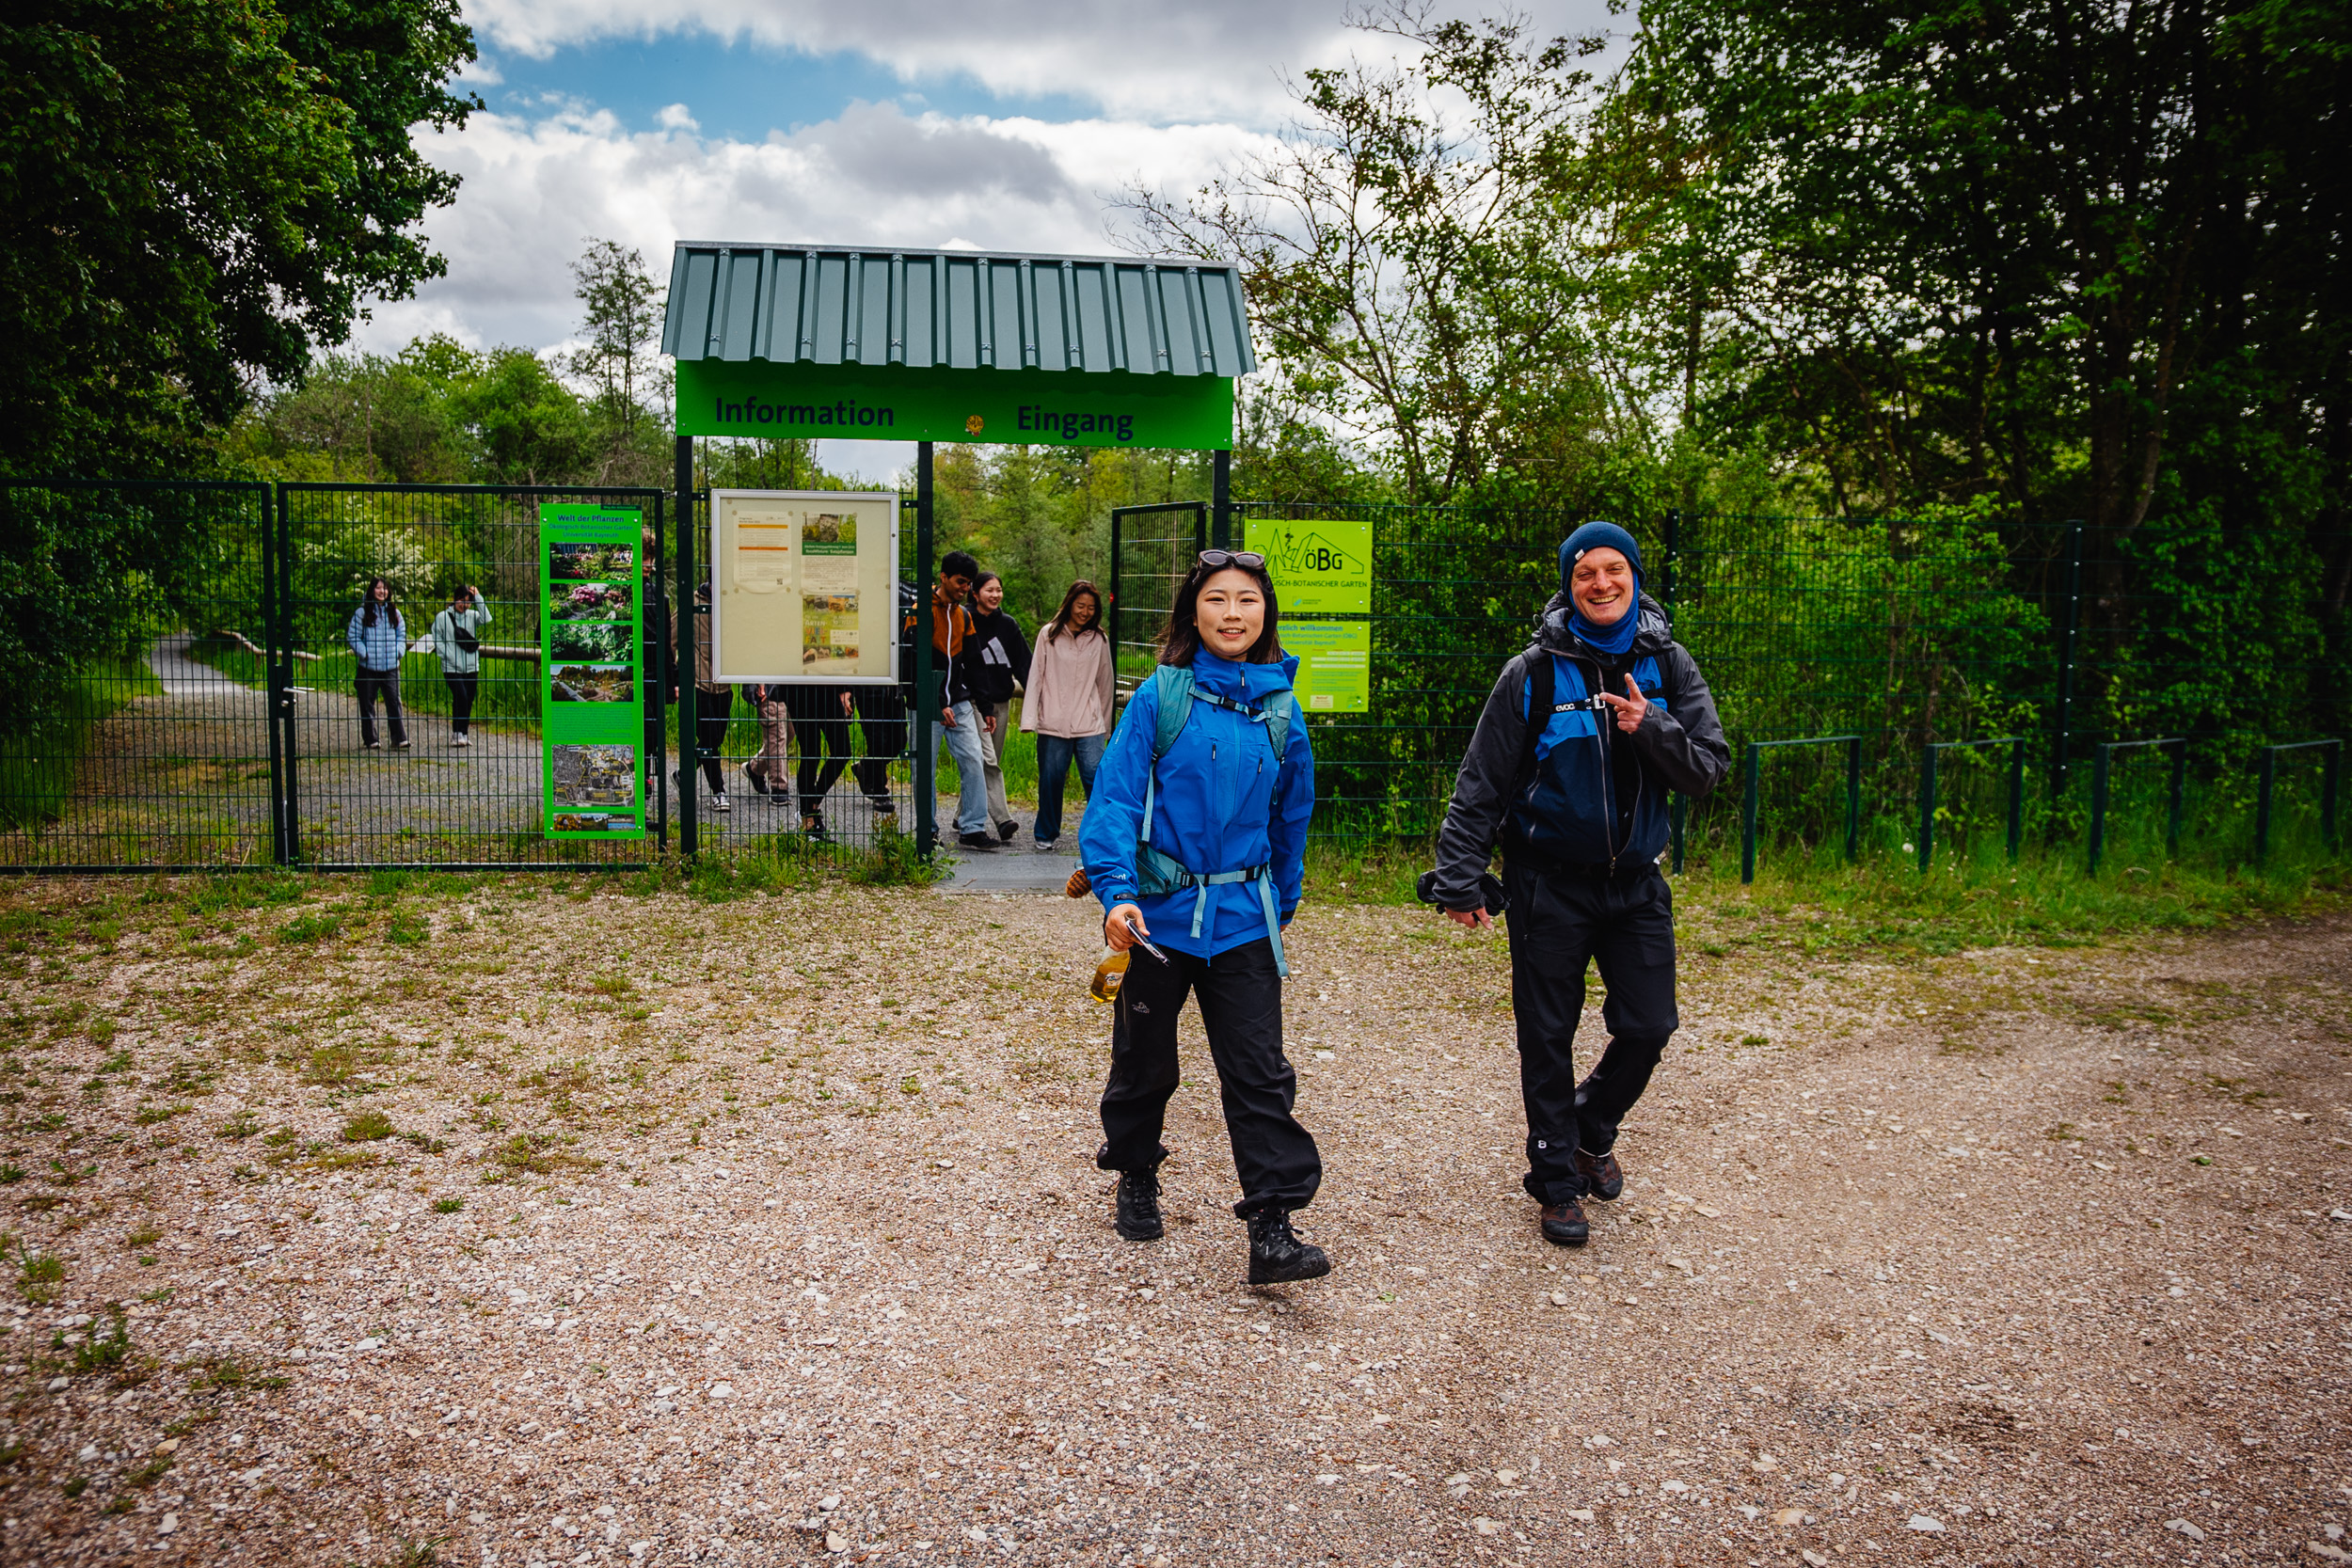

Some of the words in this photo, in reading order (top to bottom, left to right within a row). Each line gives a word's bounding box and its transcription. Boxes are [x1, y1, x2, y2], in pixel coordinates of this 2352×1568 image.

[716, 396, 894, 426] Information
[1018, 404, 1134, 441] Eingang
[592, 515, 625, 523] Pflanzen
[1305, 547, 1343, 571] ÖBG
[1341, 579, 1368, 588] GARTEN
[1300, 624, 1343, 632] willkommen
